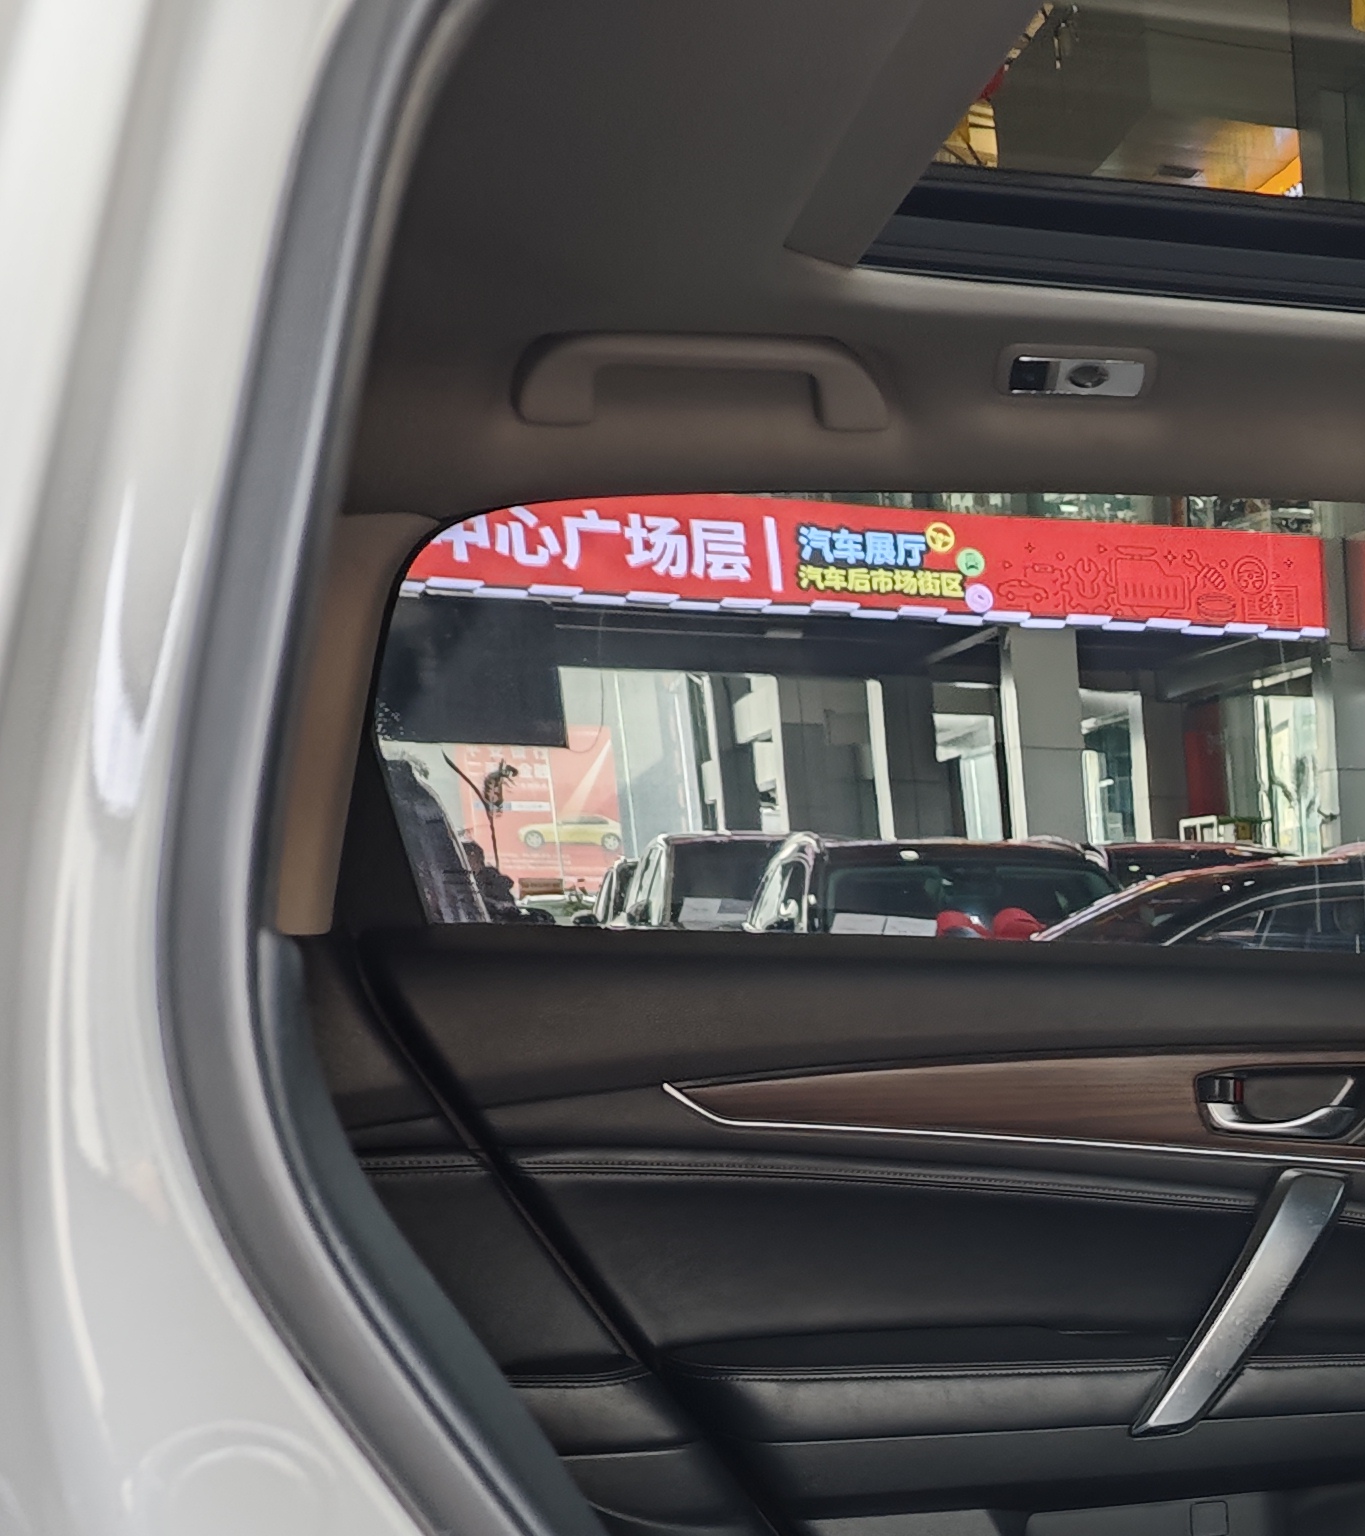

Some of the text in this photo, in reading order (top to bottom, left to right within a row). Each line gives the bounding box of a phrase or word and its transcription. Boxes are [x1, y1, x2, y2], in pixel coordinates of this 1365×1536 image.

[431, 505, 751, 582] 中心广场层
[798, 526, 927, 568] 汽车展厅
[798, 567, 966, 599] 汽车后市场街区
